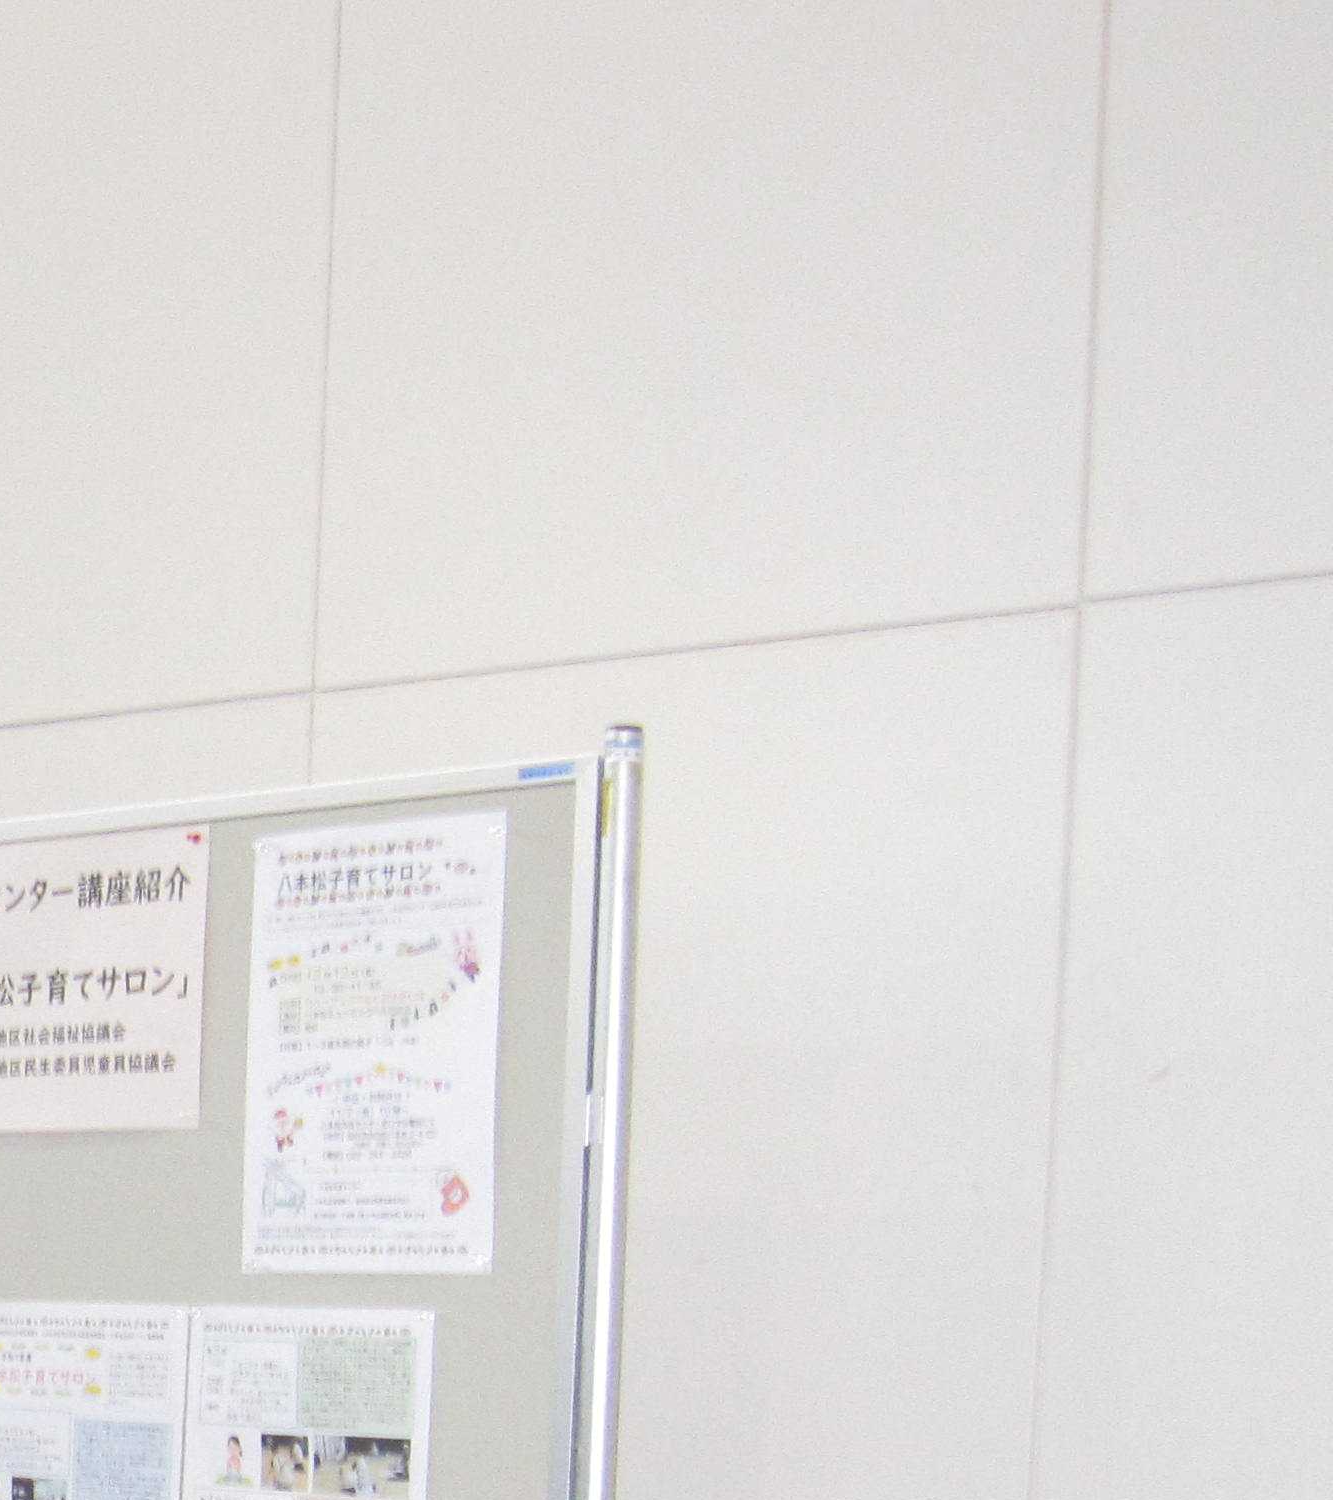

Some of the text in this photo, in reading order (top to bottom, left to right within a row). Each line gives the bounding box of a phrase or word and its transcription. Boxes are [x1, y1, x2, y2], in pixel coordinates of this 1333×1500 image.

[277, 862, 432, 899] 八本松子育てサロン
